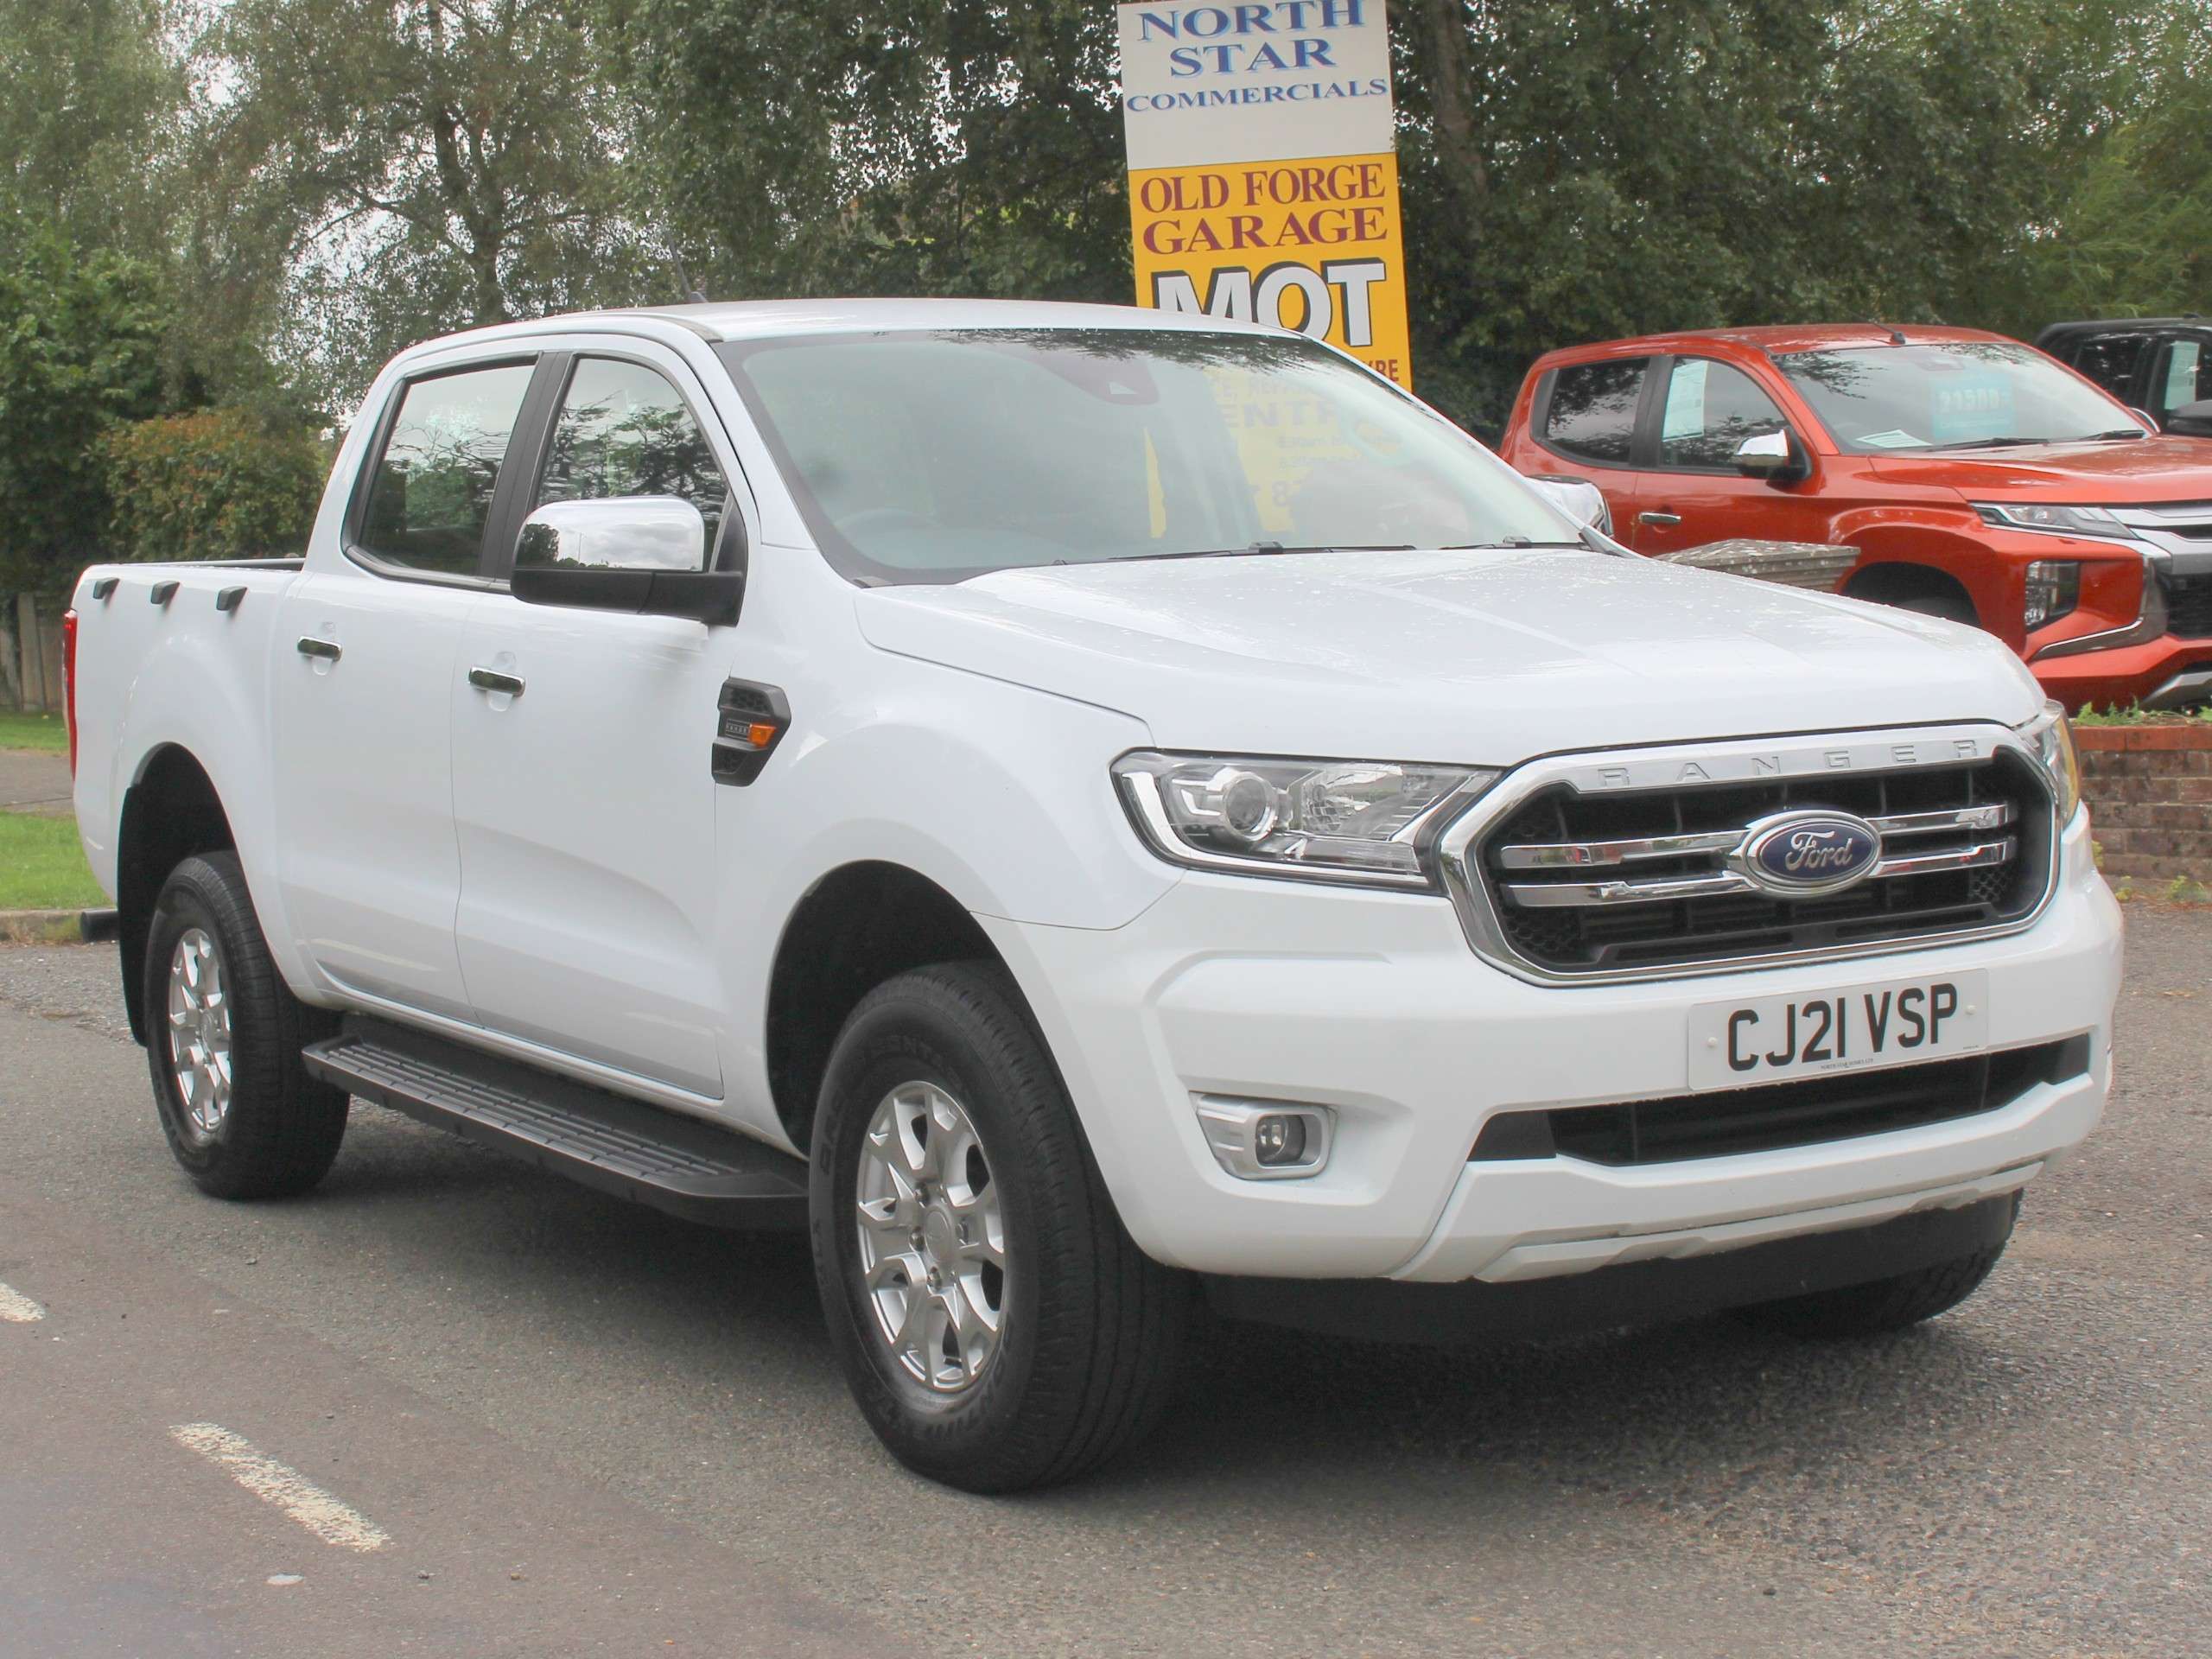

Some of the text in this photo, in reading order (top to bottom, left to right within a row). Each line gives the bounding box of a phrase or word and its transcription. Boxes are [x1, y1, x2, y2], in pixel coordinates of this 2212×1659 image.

[1137, 0, 1367, 41] NORTH
[1169, 38, 1337, 77] STAR
[1127, 79, 1389, 112] COMMERCIALS
[1140, 163, 1386, 213] OLD FORGE
[1142, 207, 1388, 255] GARAGE
[1151, 257, 1386, 346] MOT
[1368, 359, 1399, 382] RE
[1597, 740, 1979, 788] RANGER
[1785, 830, 1853, 872] Ford
[1728, 982, 1958, 1071] CJ21 VSP
